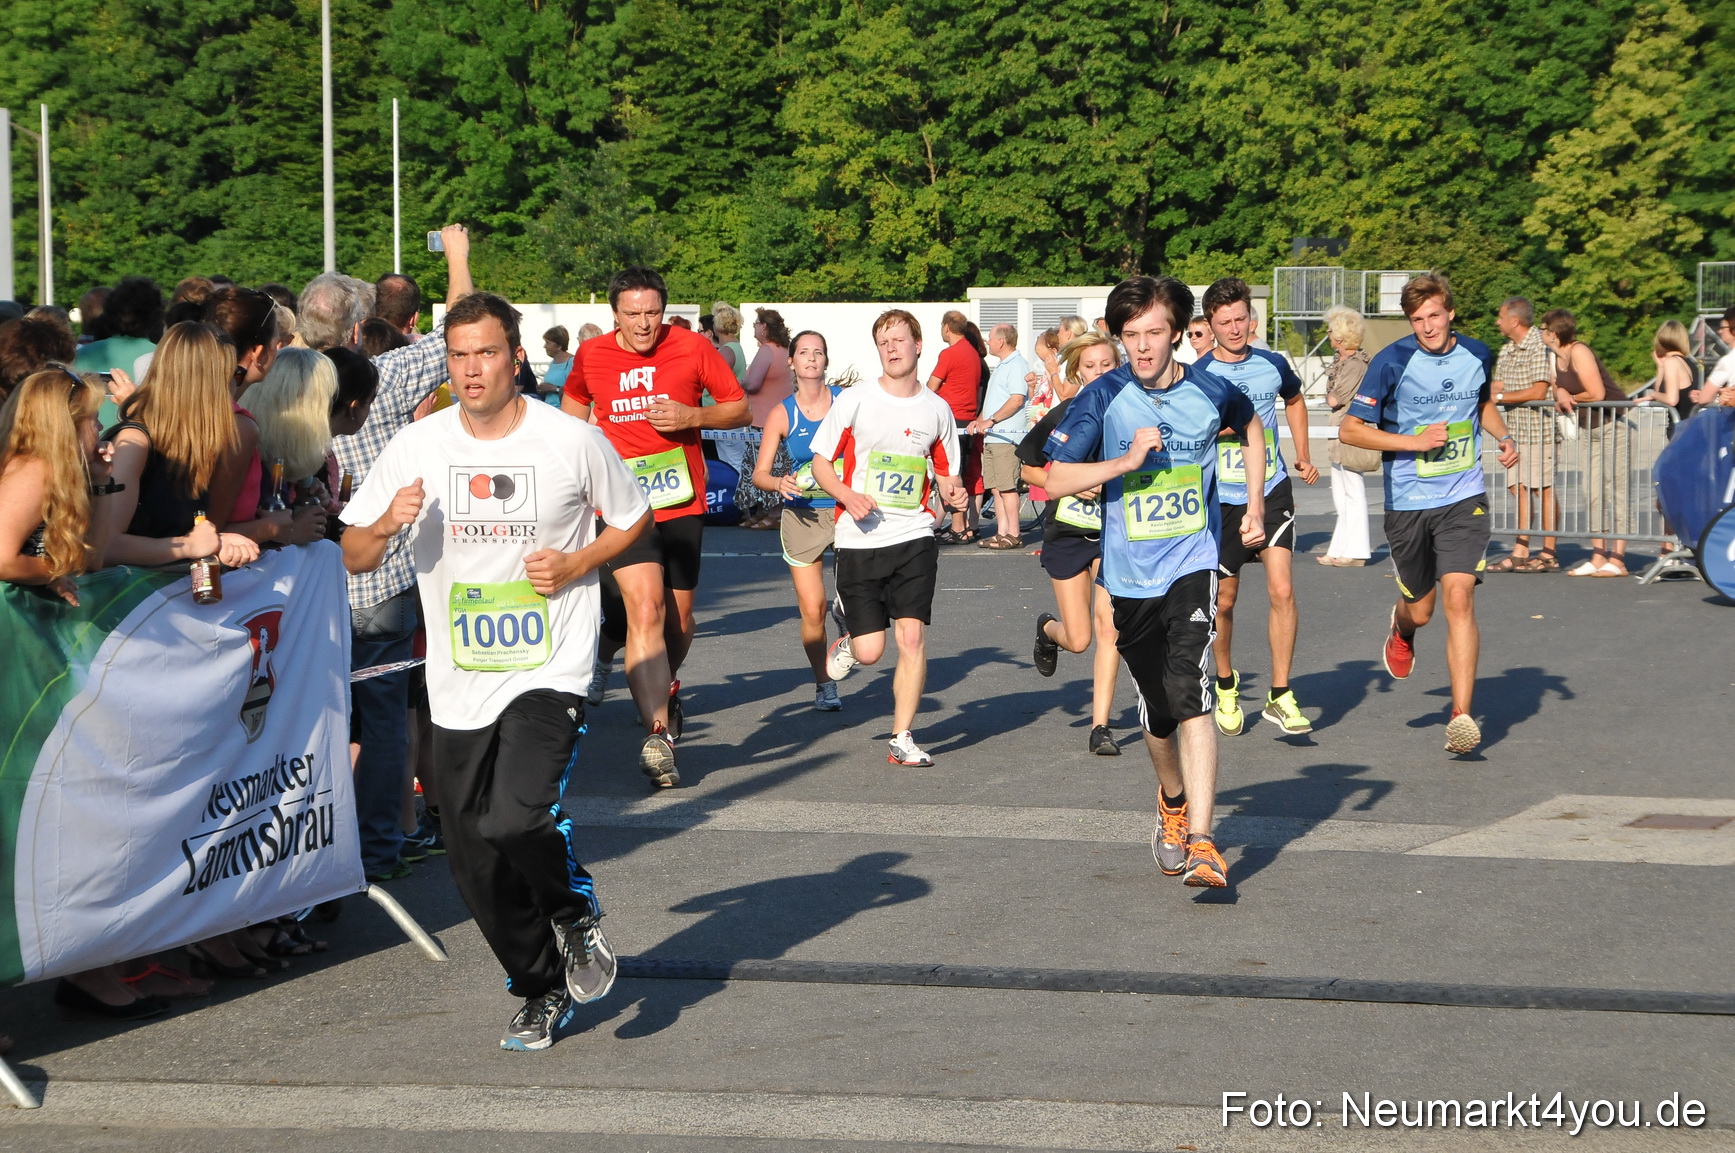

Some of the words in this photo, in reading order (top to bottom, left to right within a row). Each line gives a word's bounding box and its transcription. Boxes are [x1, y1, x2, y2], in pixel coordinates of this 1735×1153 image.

[619, 366, 656, 392] MRT
[609, 412, 648, 424] Runnin
[1152, 456, 1176, 464] TEAM
[1221, 447, 1274, 469] 124
[875, 471, 915, 495] 124
[1128, 488, 1200, 522] 1236
[450, 524, 537, 536] POLGER
[453, 611, 544, 648] 1000
